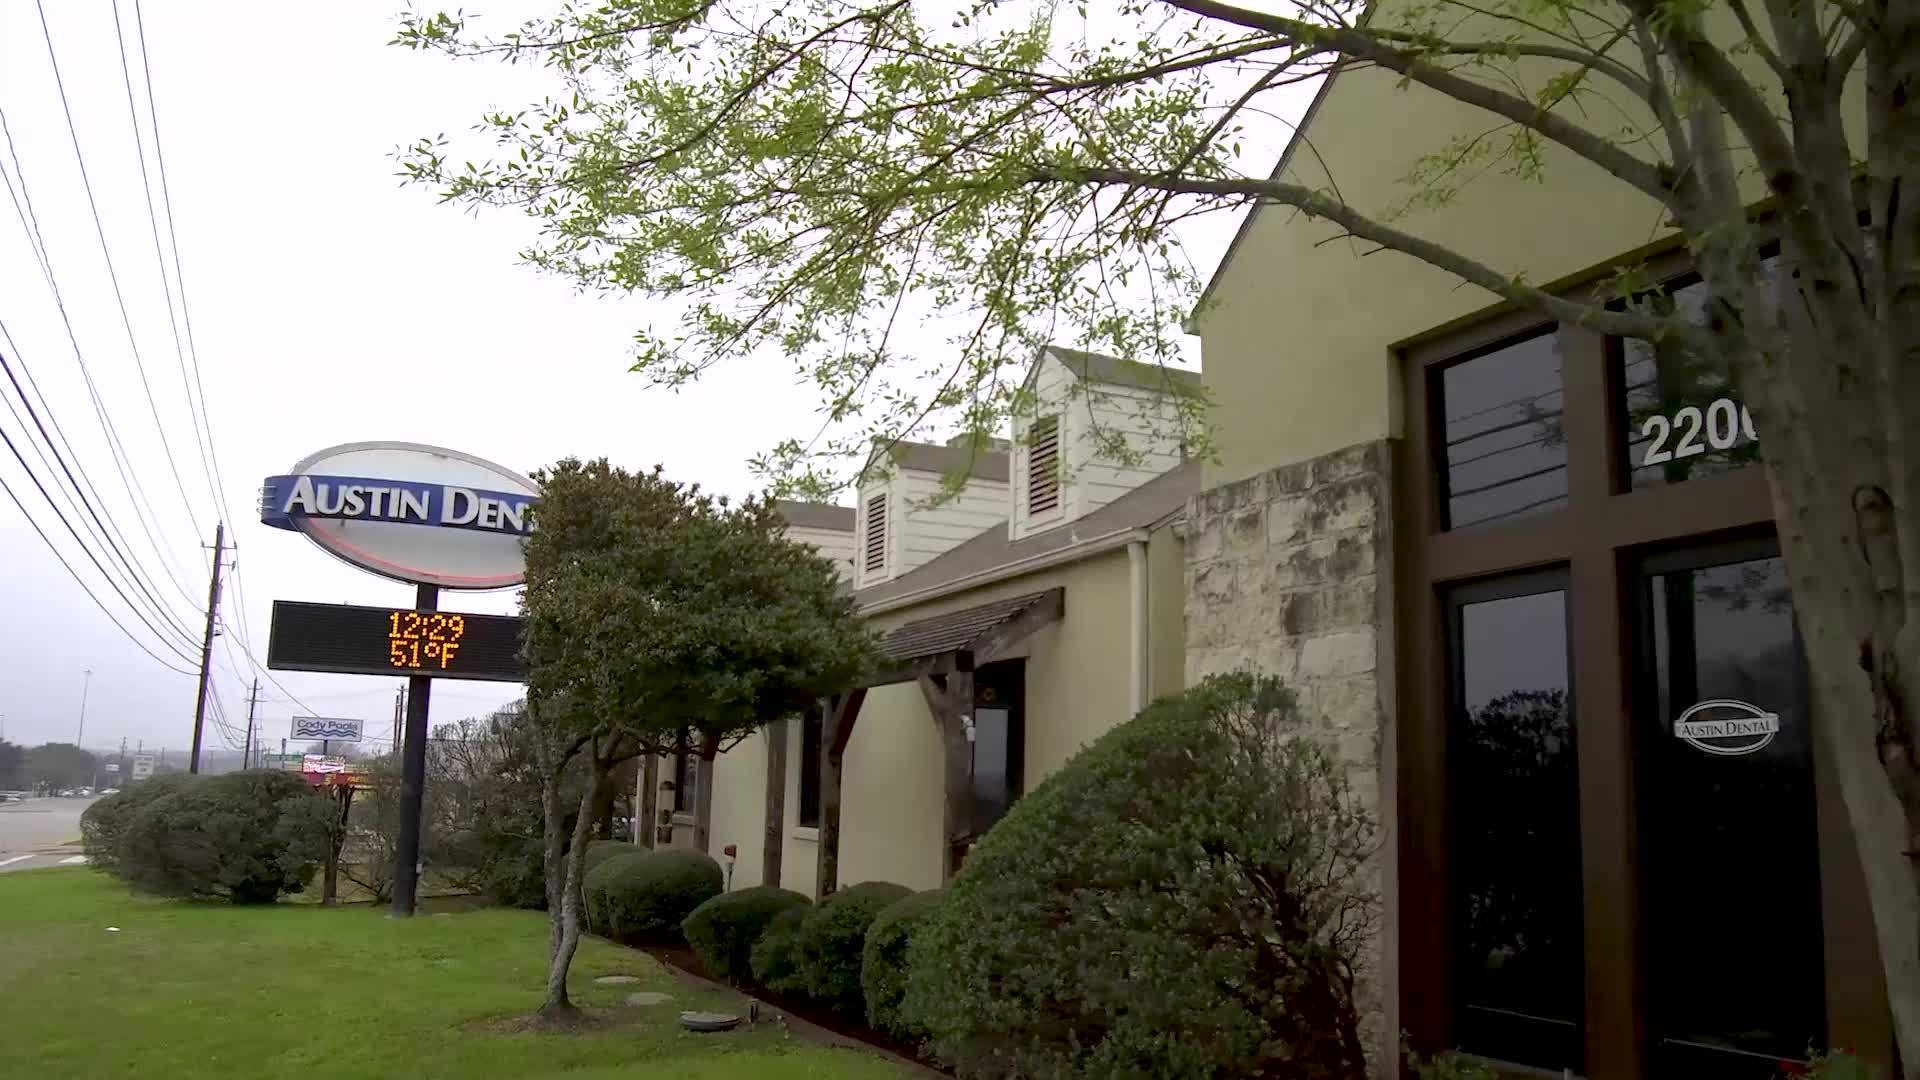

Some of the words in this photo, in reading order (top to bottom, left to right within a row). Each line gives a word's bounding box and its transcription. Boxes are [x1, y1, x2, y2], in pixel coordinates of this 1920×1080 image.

[283, 476, 429, 521] AUSTIN
[389, 611, 464, 641] 12:29
[297, 719, 326, 730] Cody
[328, 721, 358, 731] Pools
[1682, 724, 1722, 737] AUSTIN
[1726, 720, 1773, 735] DENTAL
